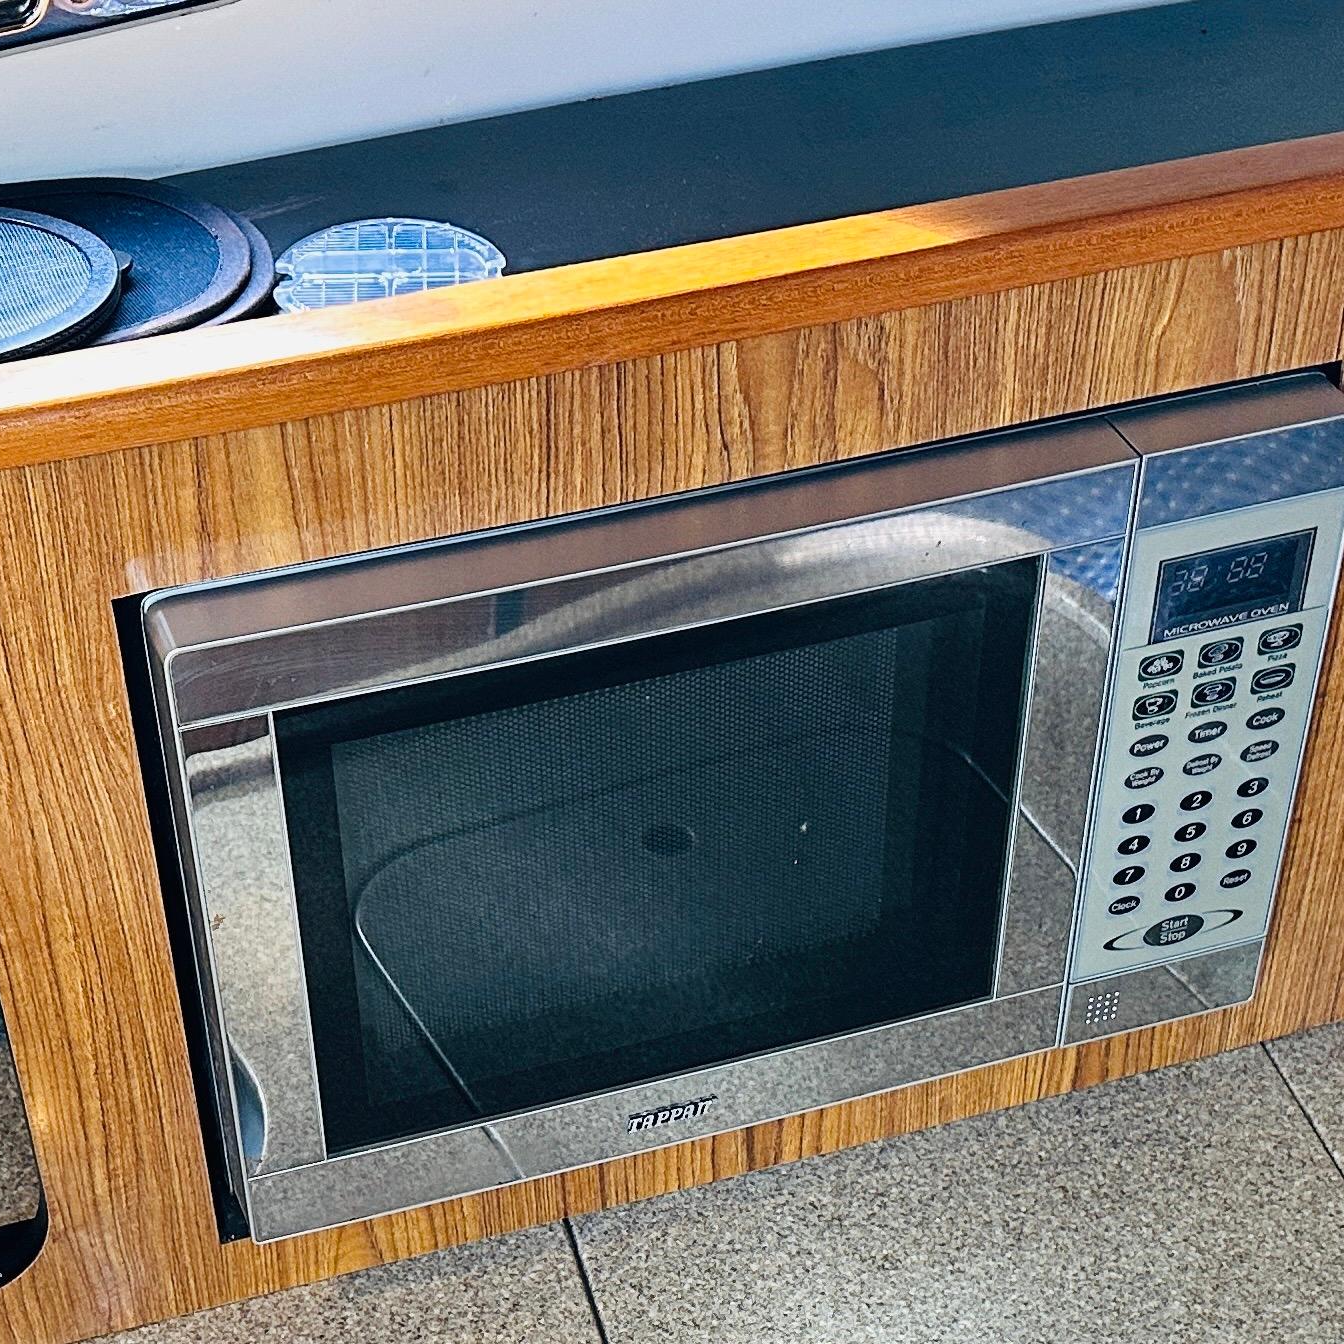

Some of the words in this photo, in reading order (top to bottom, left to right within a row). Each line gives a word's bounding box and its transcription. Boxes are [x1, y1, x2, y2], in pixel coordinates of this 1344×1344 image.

[1163, 611, 1248, 638] MICROWAVE
[1250, 602, 1291, 619] OVEN
[1193, 669, 1217, 680] Baked
[1143, 678, 1175, 690] Popcorn
[1185, 708, 1211, 720] Frozen
[1252, 712, 1279, 726] Cook
[1134, 717, 1171, 730] Beverage
[1194, 725, 1223, 740] Timer
[1133, 739, 1165, 754] Power
[1247, 780, 1259, 794] 3
[1191, 794, 1202, 808] 2
[1135, 808, 1142, 821] 1
[1242, 812, 1253, 825] 6
[1185, 825, 1196, 838] 5
[1128, 838, 1139, 851] 4
[1237, 842, 1247, 855] 9
[1180, 855, 1191, 869] 8
[1124, 868, 1135, 882] 7
[1223, 872, 1248, 886] Reset
[1174, 886, 1186, 899] 0
[1111, 900, 1137, 912] Clock
[1161, 917, 1189, 932] Start
[1160, 930, 1187, 944] Stop
[627, 1097, 718, 1134] TAPPAN
